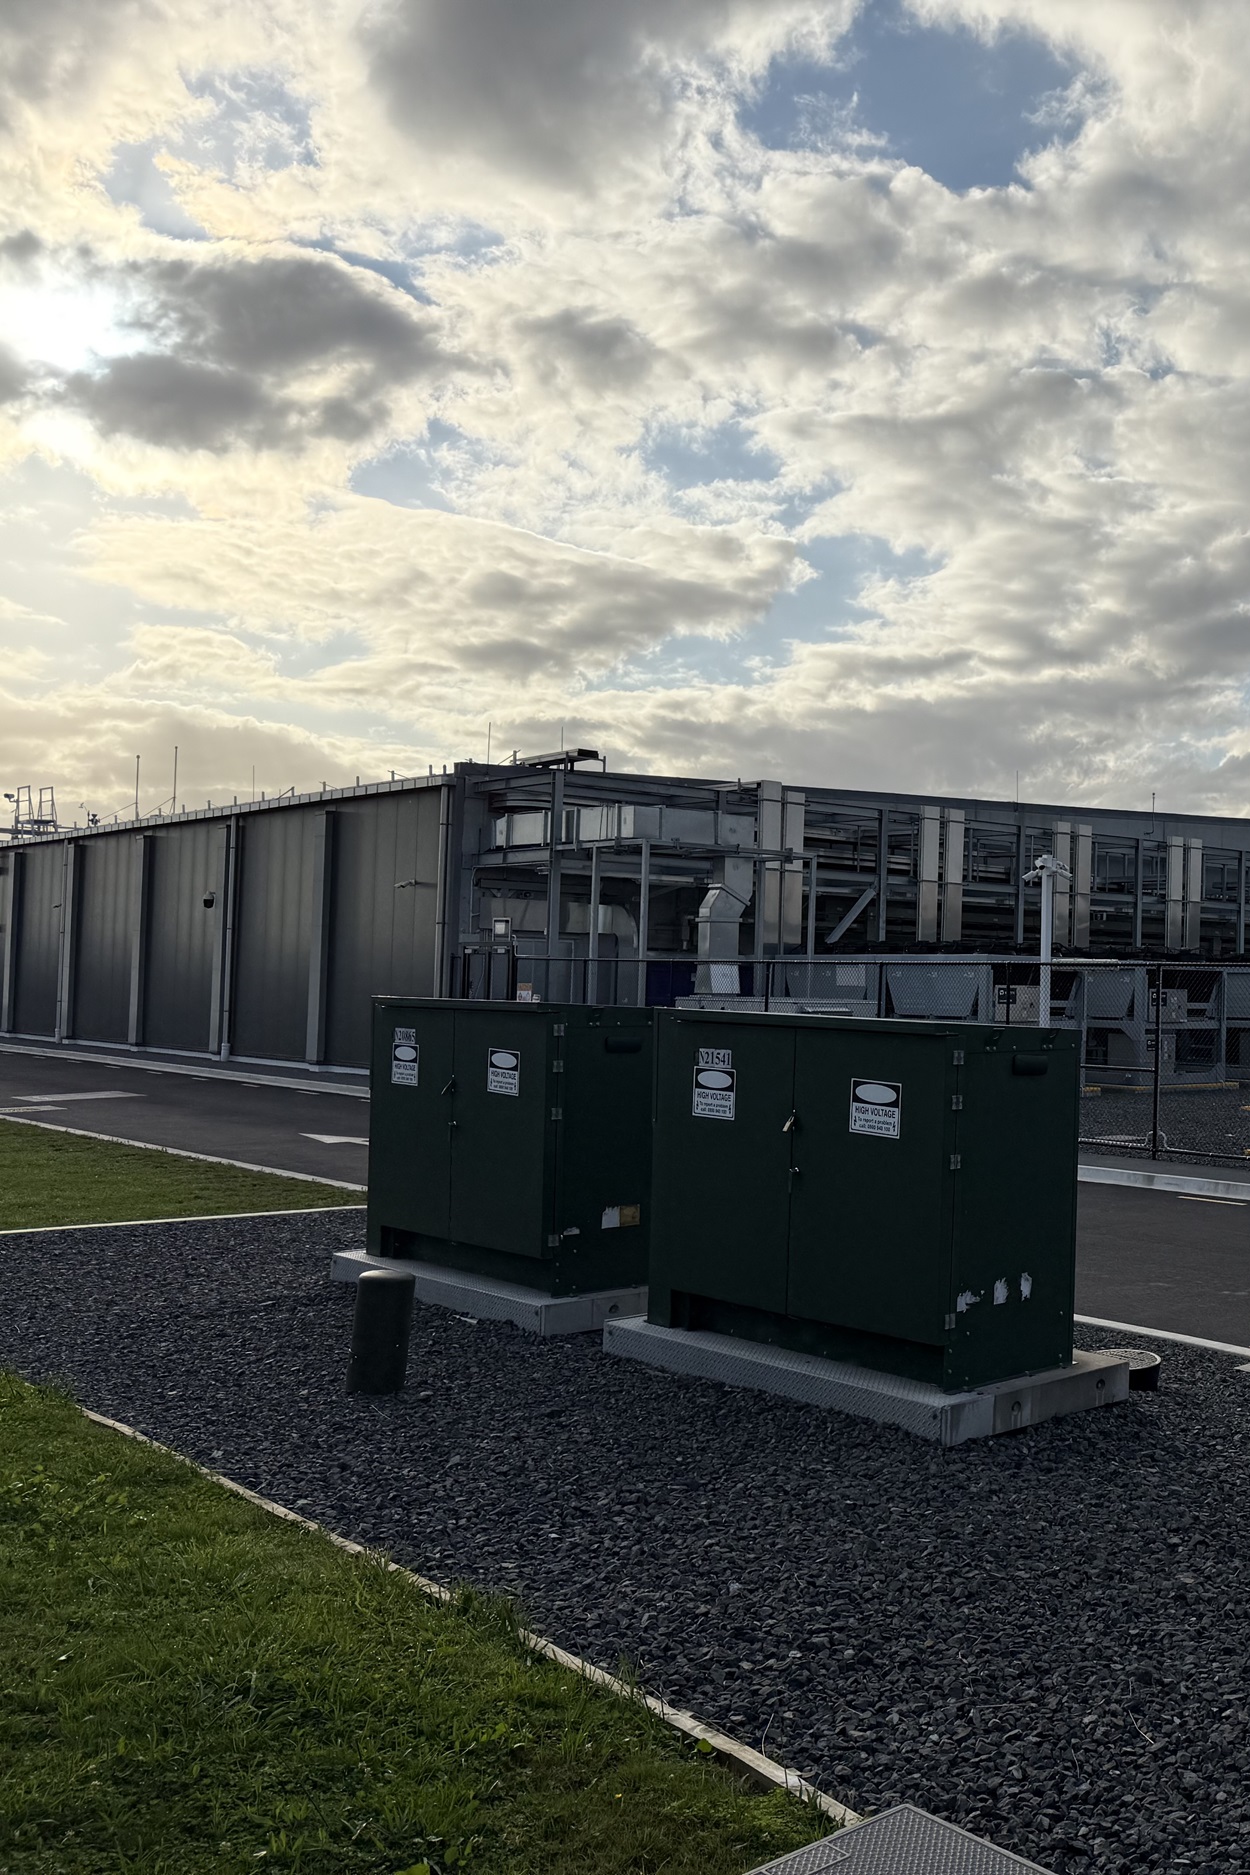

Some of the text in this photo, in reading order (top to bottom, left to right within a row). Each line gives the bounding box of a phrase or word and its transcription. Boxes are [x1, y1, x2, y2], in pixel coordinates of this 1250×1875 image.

[698, 1051, 731, 1066] N21541
[697, 1091, 732, 1102] HIGH VOLTAGE
[855, 1105, 896, 1119] HIGH VOLTAGE
